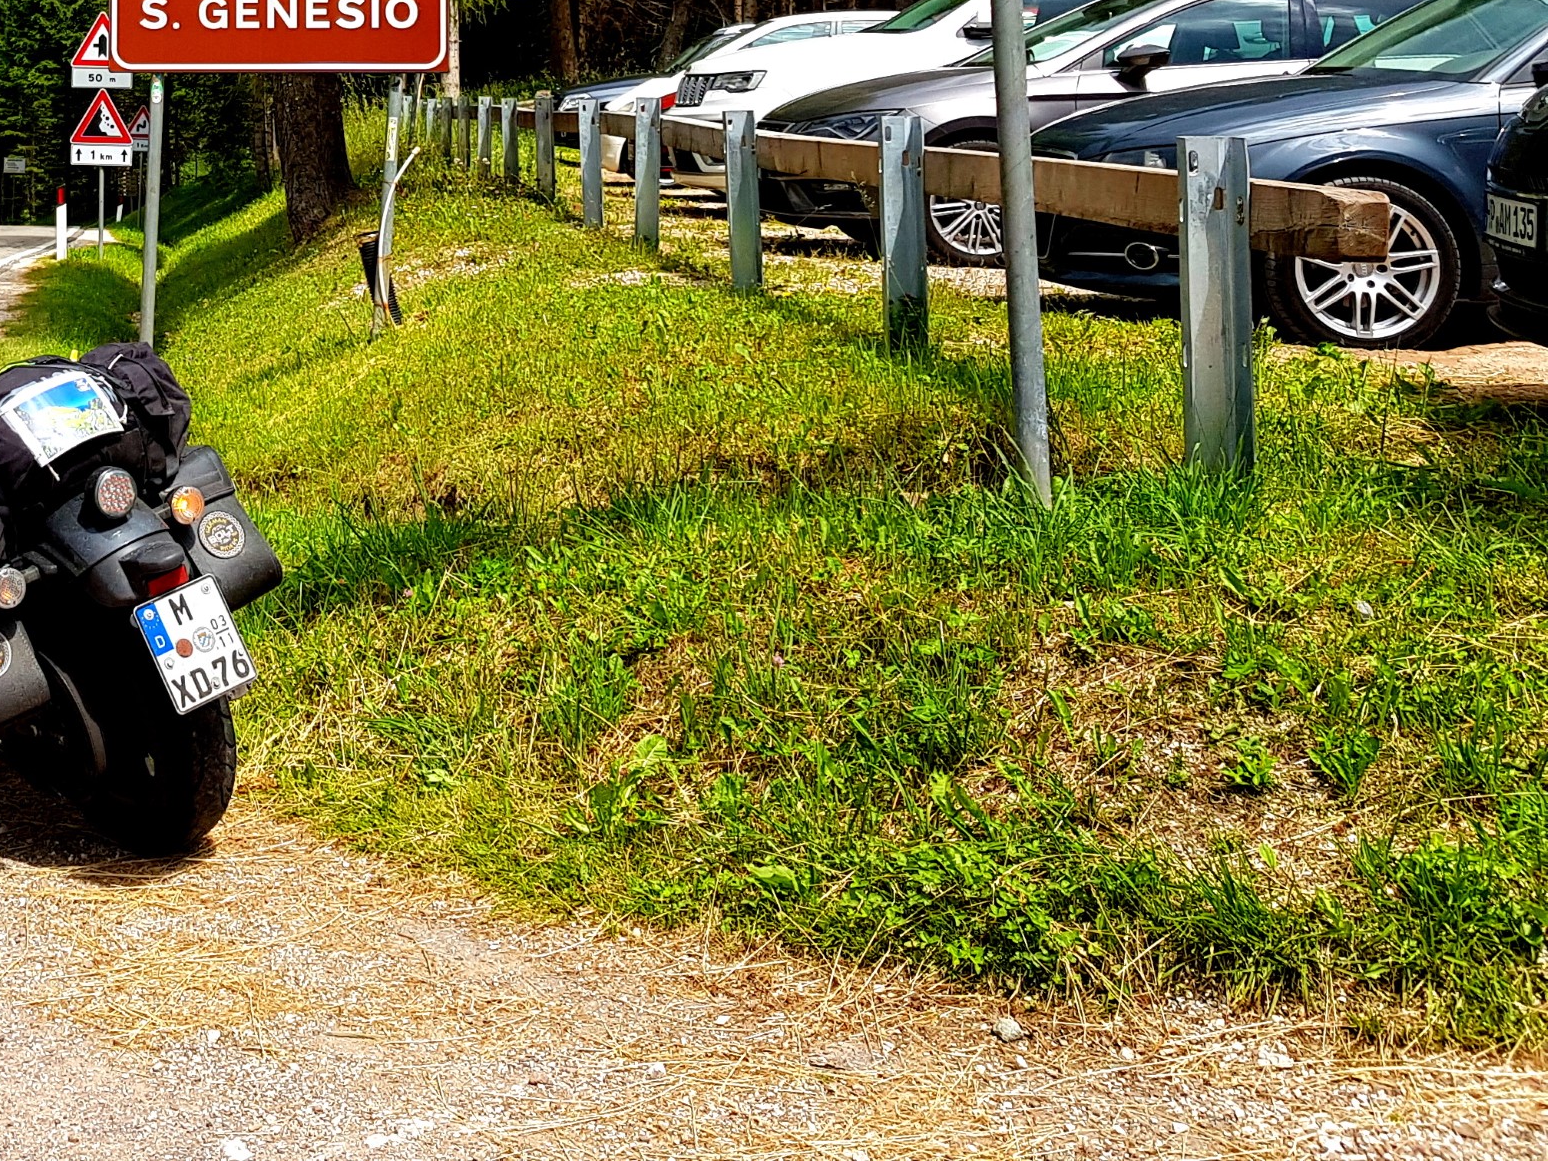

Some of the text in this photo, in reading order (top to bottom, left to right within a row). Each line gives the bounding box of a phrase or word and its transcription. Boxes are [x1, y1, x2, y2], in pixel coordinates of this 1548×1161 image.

[88, 73, 103, 83] 50
[90, 149, 95, 160] 1
[1513, 205, 1534, 241] 135
[207, 524, 234, 545] BOLT
[168, 593, 193, 626] M
[154, 635, 166, 649] D
